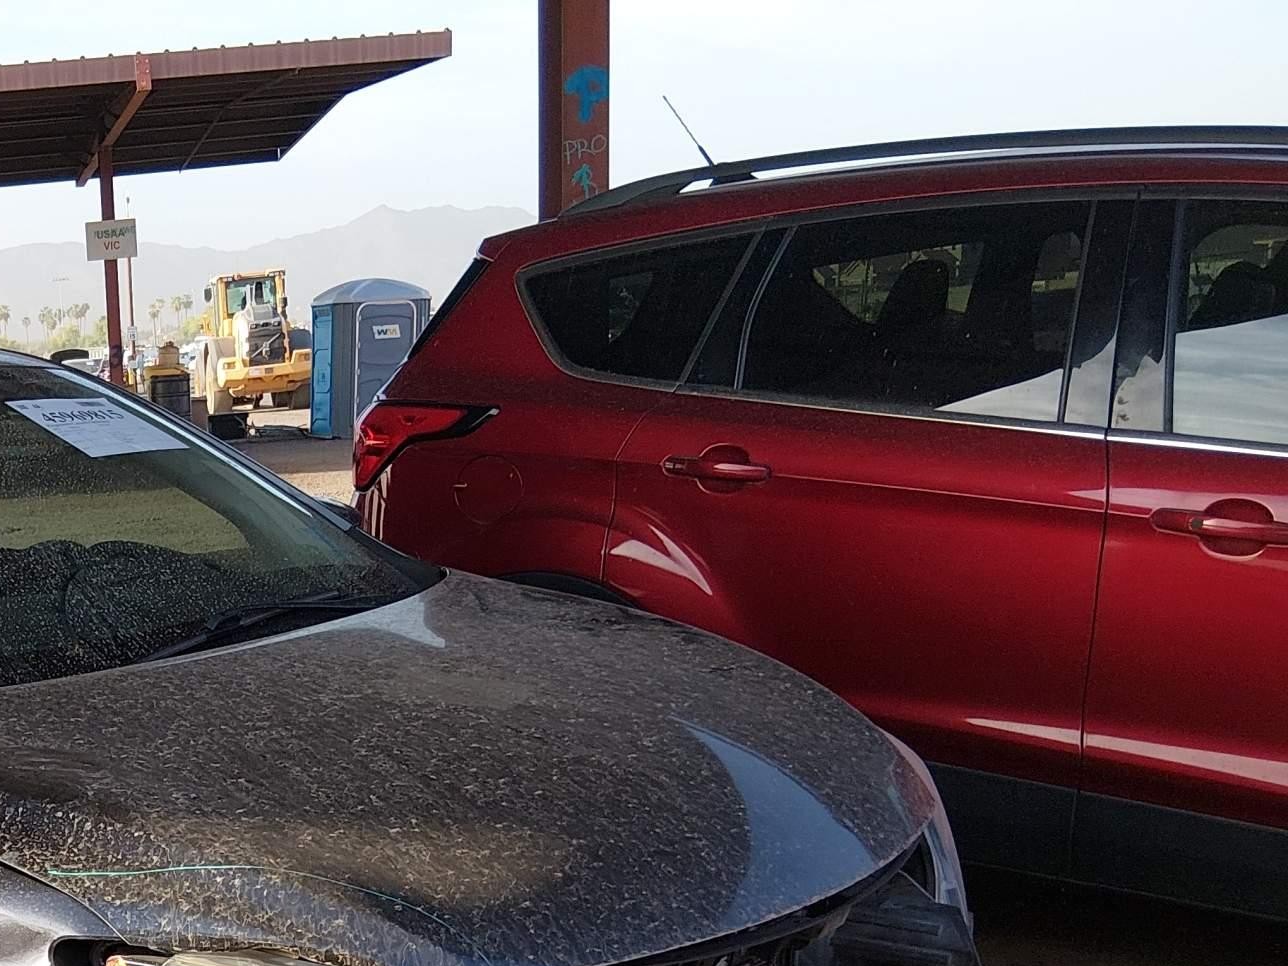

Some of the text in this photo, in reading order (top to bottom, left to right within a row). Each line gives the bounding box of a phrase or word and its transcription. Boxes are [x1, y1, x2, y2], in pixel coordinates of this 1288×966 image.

[563, 134, 608, 165] PRO
[103, 240, 121, 251] VIC
[40, 408, 125, 424] 45969815
